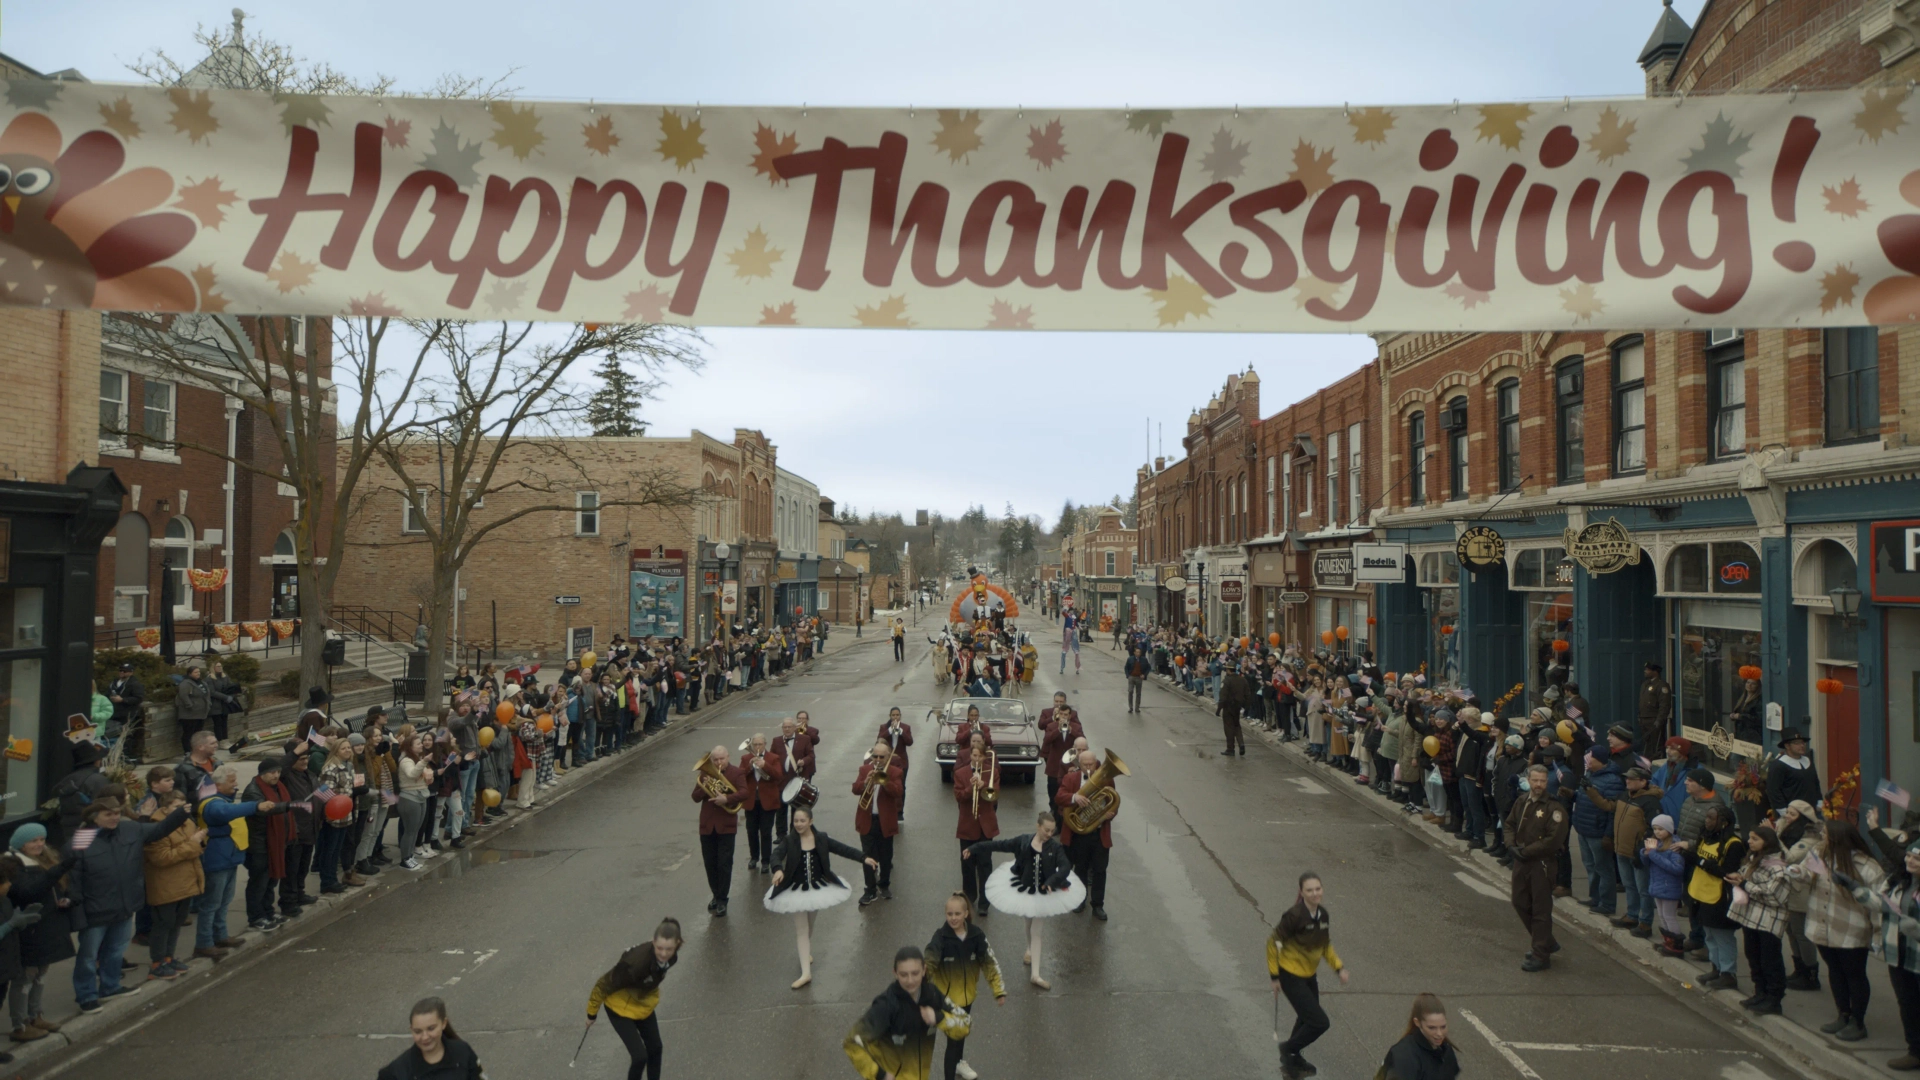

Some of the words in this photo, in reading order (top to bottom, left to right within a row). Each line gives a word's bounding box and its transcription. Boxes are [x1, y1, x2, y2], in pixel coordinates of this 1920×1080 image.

[242, 121, 731, 317] Happy
[771, 114, 1821, 322] Thanksgiving!
[1458, 527, 1479, 553] PORT
[1481, 527, 1505, 565] SOCIAL
[1573, 542, 1632, 551] MARWAN'S
[1363, 557, 1397, 565] Modella
[1558, 567, 1574, 580] OPE
[1720, 565, 1749, 580] OPEN
[574, 637, 592, 647] POLICE
